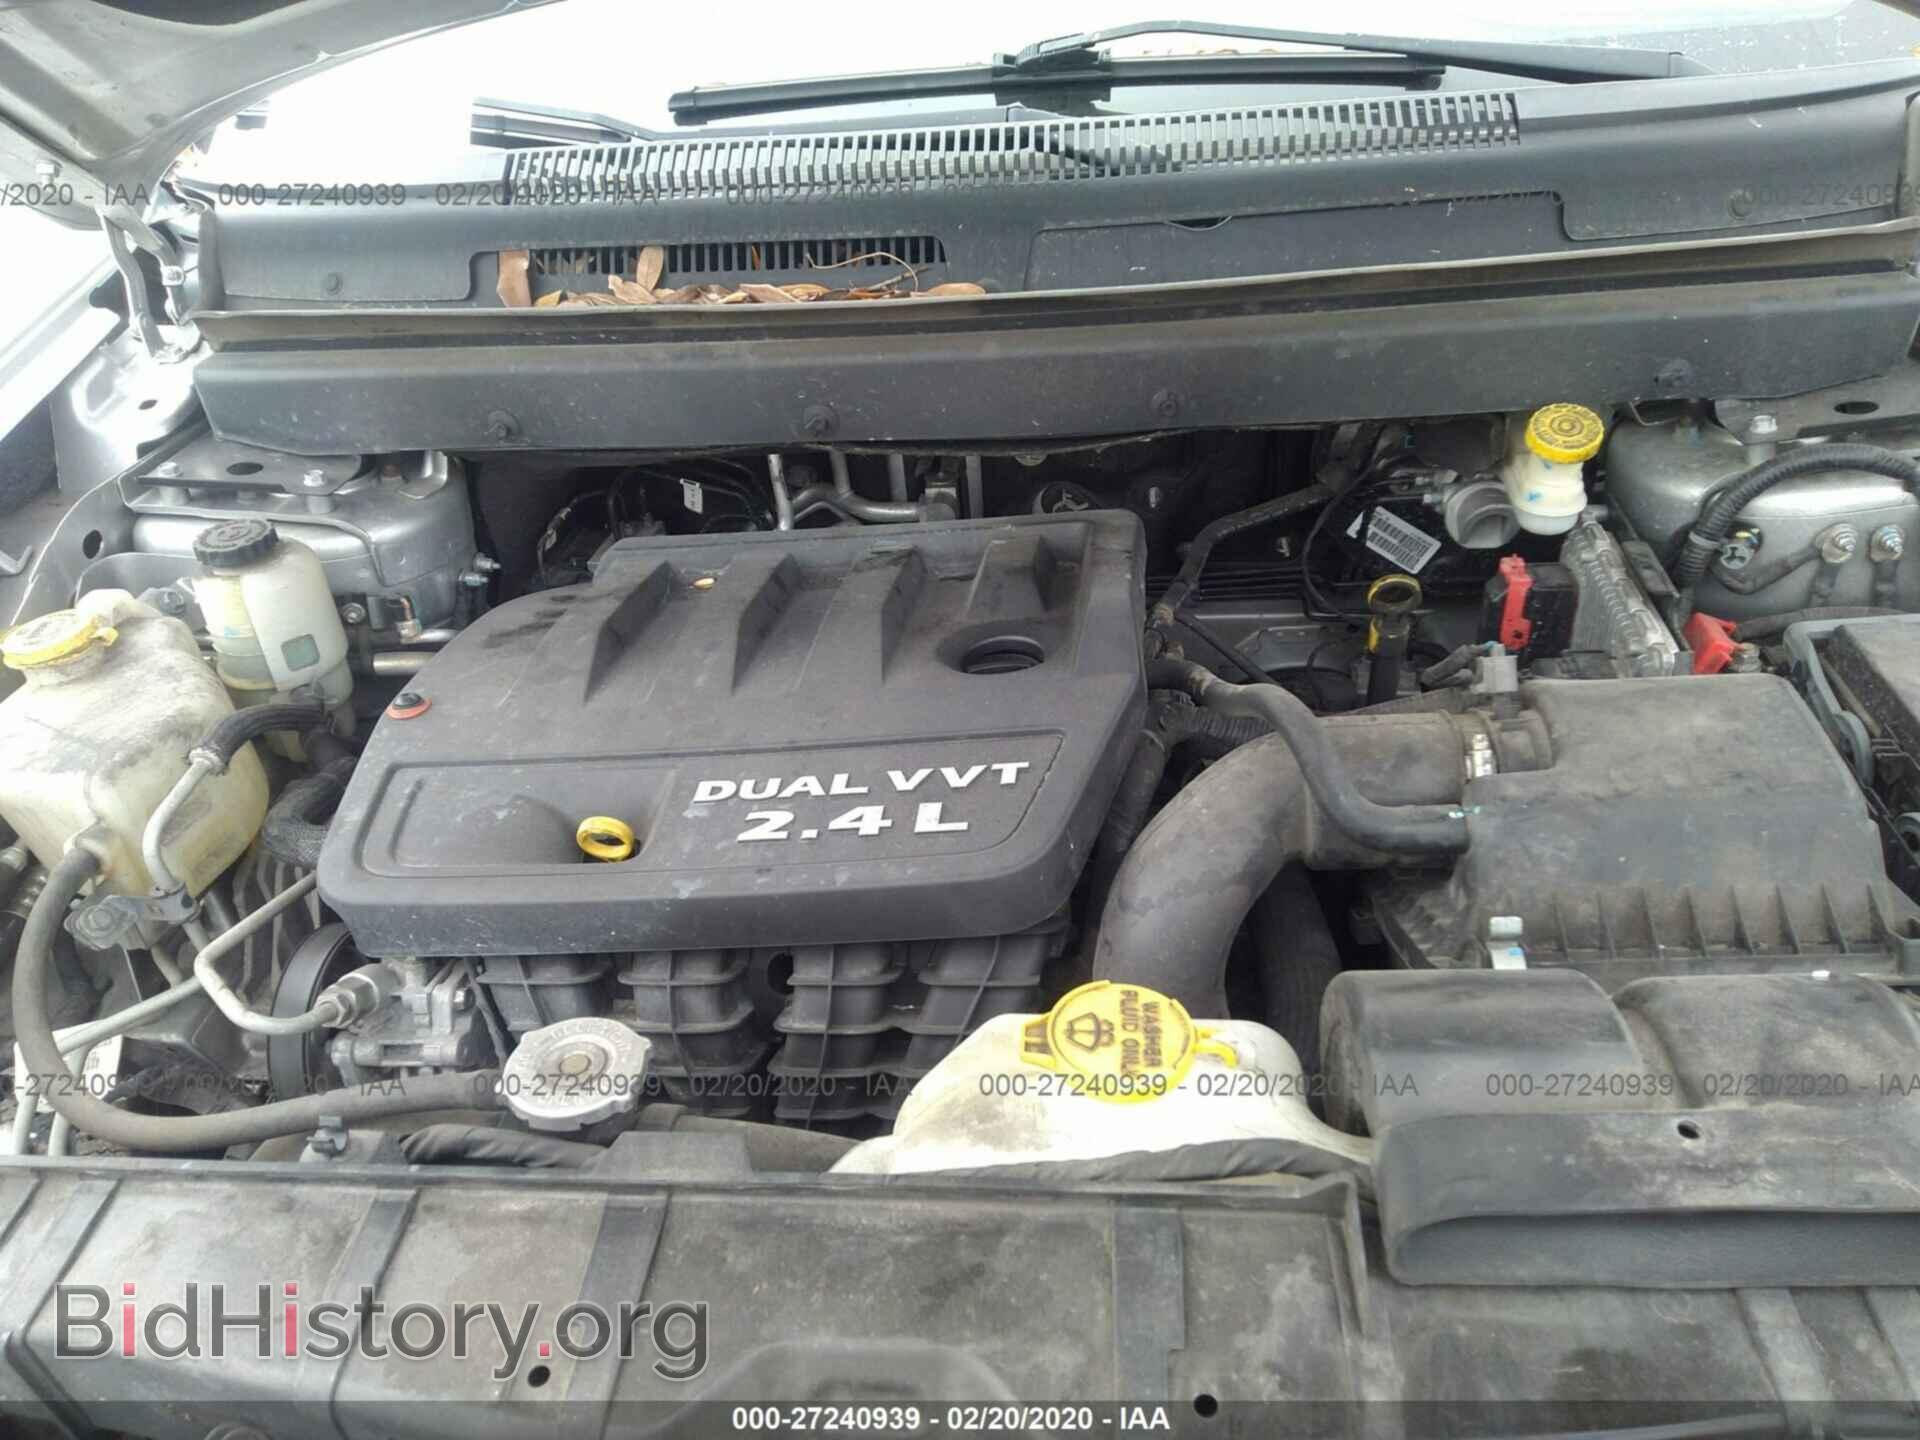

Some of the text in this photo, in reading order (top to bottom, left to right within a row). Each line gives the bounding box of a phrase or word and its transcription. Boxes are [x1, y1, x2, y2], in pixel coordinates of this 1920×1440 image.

[693, 761, 1029, 803] DUAL VVT
[736, 801, 968, 842] 2.4 L
[1120, 989, 1139, 1032] FLUID
[1143, 1002, 1163, 1067] WASHER
